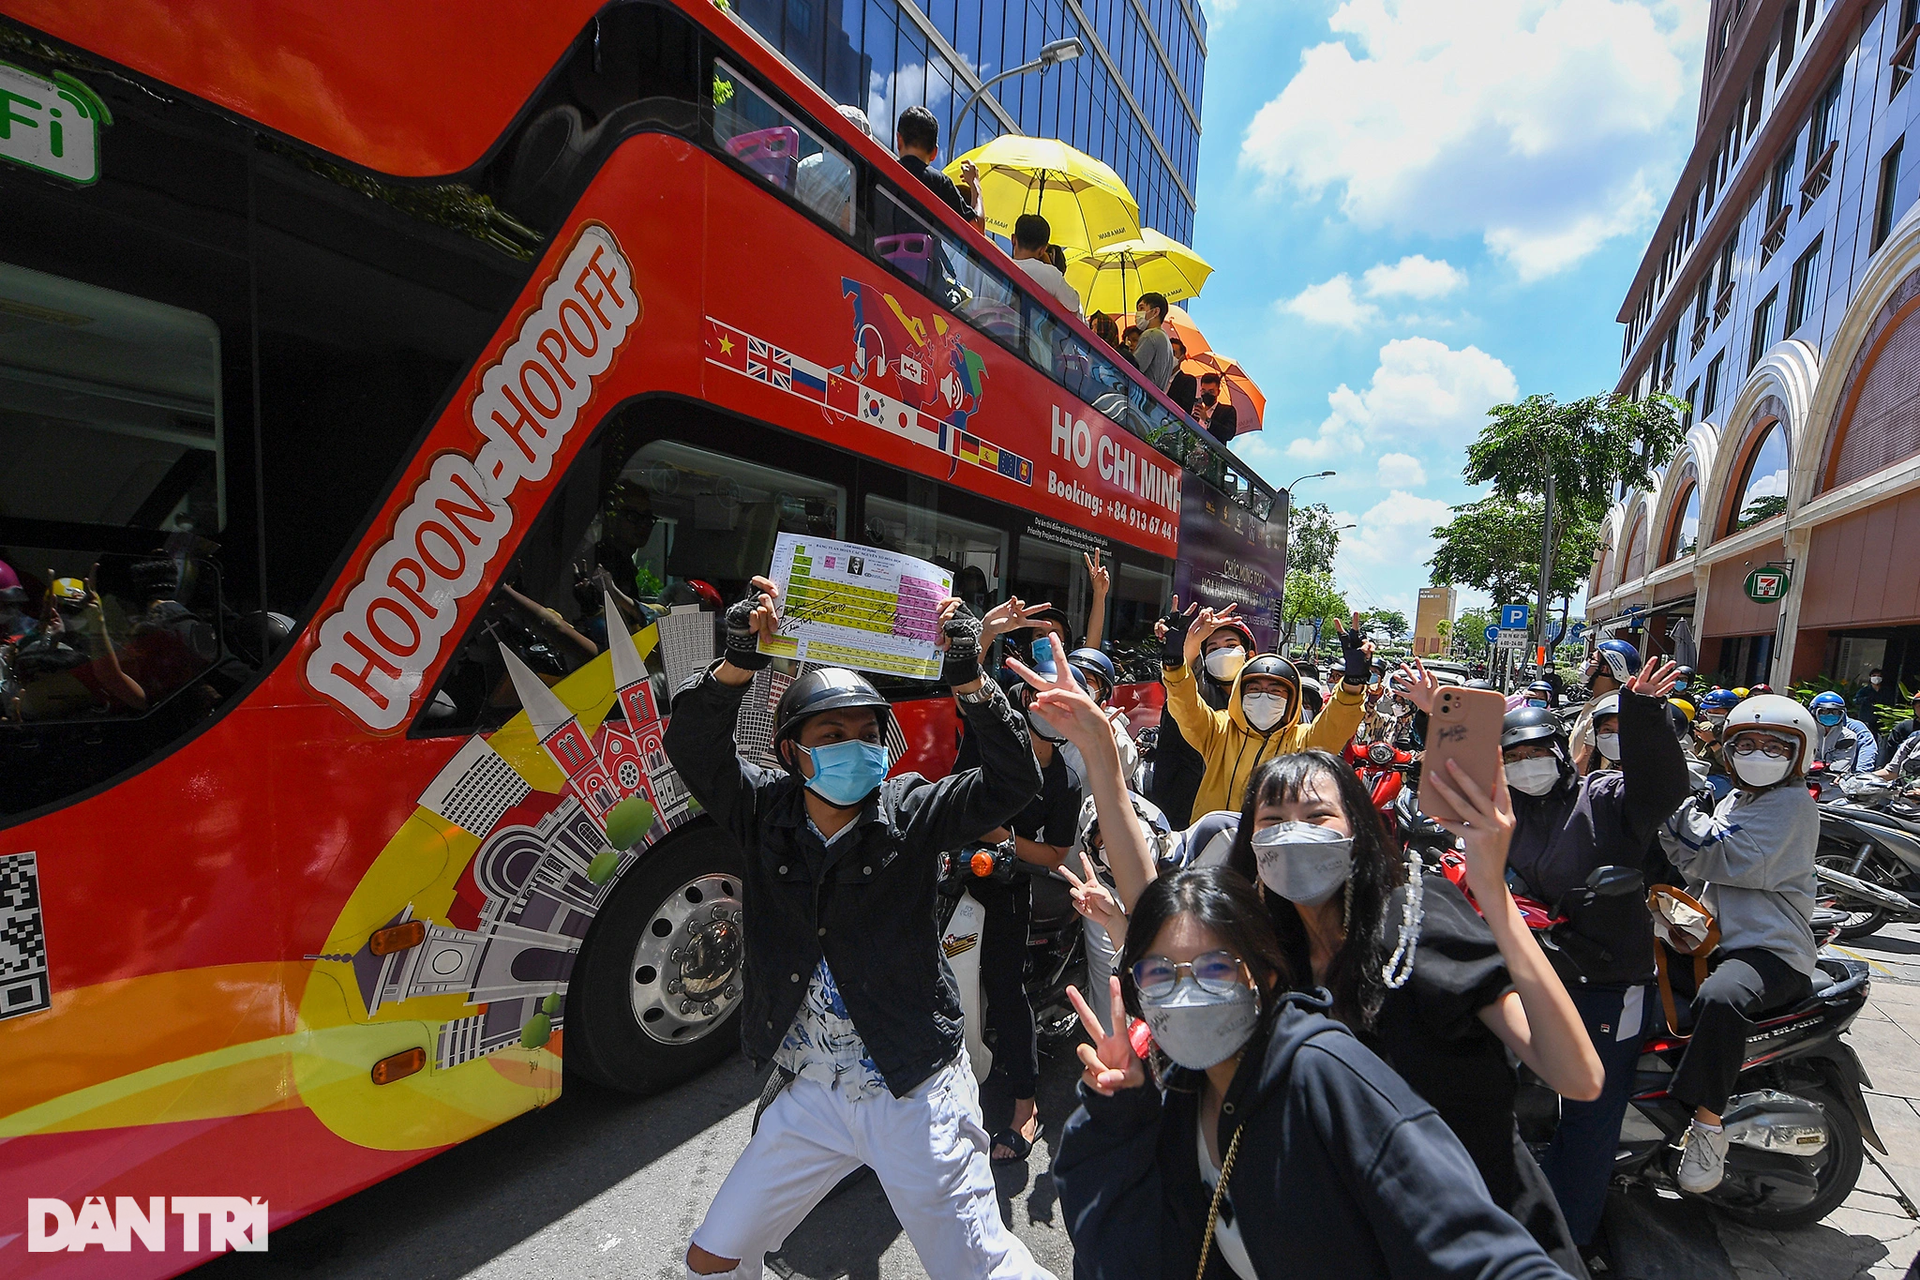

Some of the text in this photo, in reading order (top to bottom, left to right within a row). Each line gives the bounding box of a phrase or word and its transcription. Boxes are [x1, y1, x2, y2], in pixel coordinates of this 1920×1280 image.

[1051, 404, 1181, 515] HO CHI MINH
[1047, 469, 1180, 544] Booking: +84 913 67 44 1
[1510, 610, 1524, 624] P
